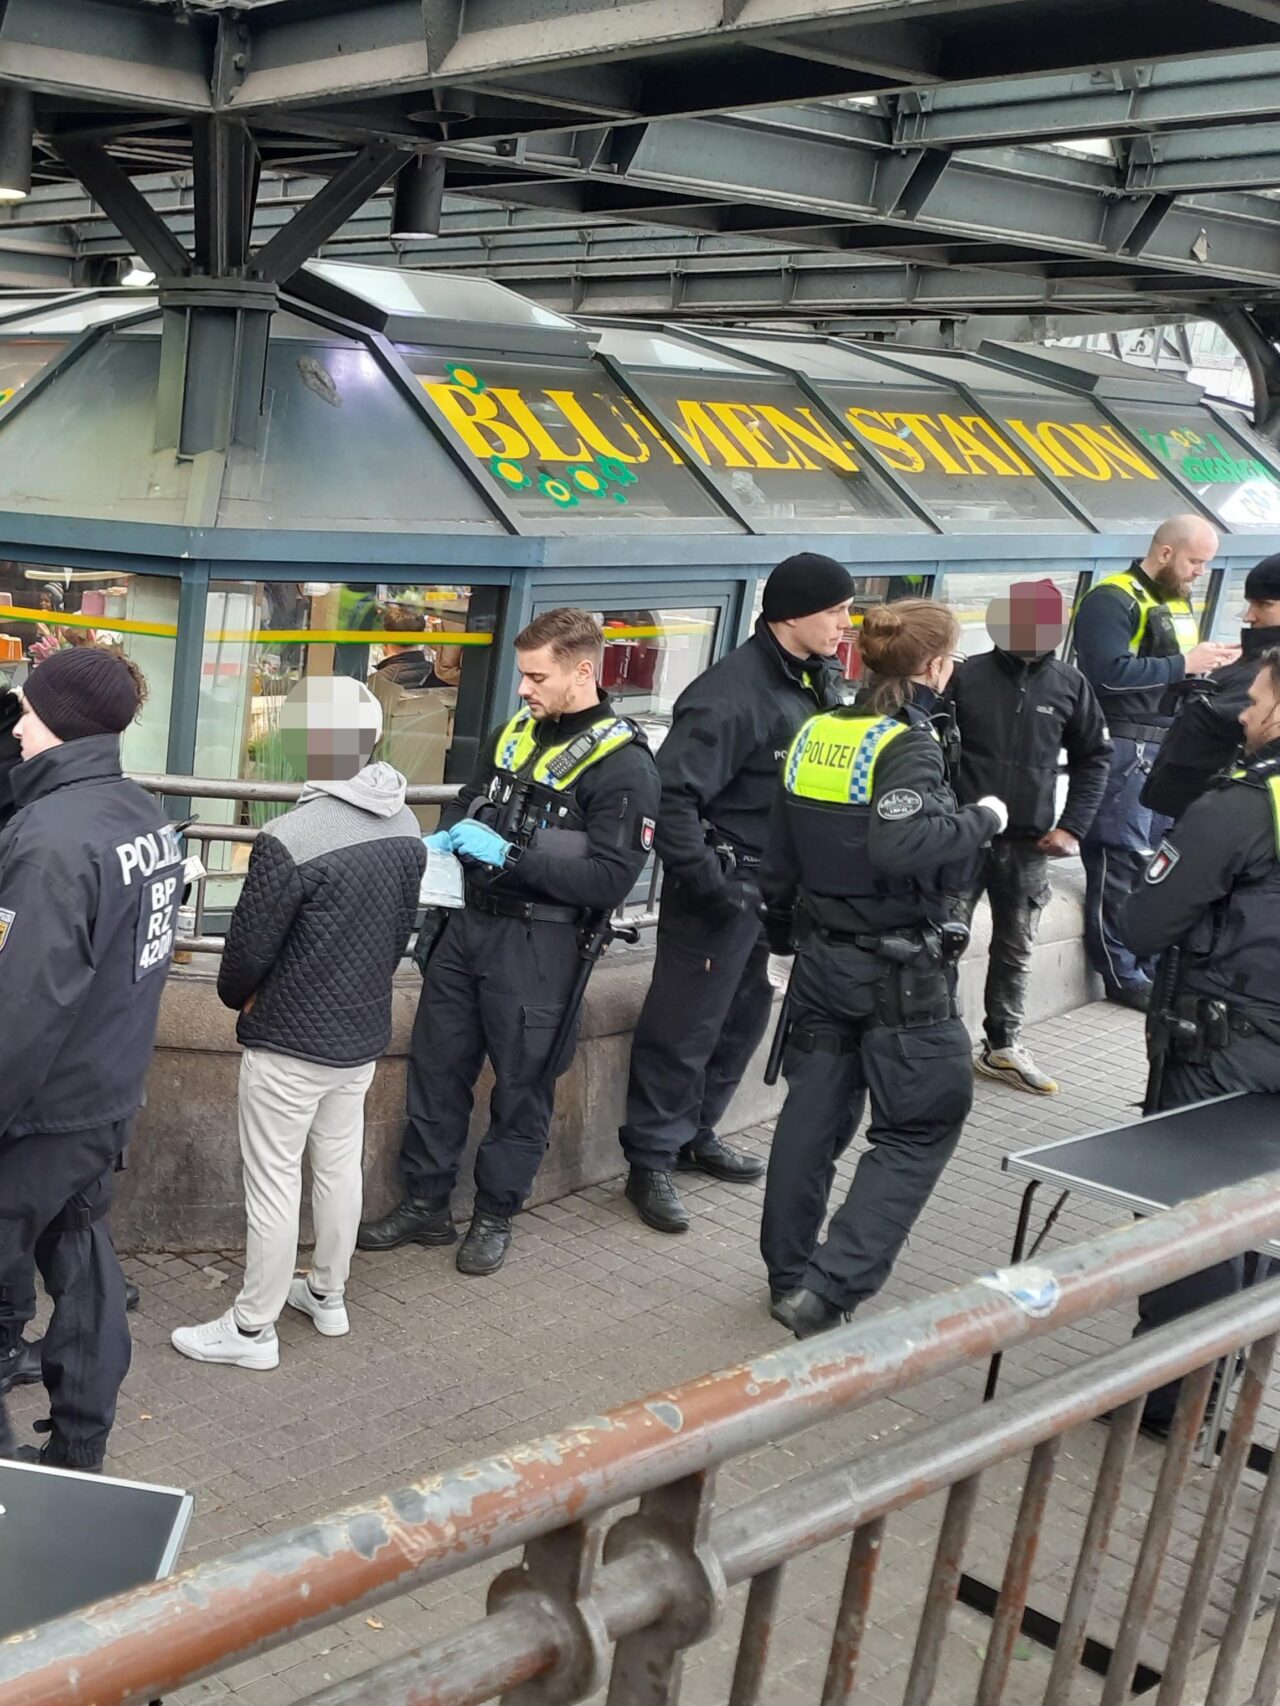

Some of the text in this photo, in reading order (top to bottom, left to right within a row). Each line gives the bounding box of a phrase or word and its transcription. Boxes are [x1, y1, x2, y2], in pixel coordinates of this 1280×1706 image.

[801, 740, 857, 769] POLIZEI
[151, 876, 177, 911] BP
[147, 905, 173, 940] RZ
